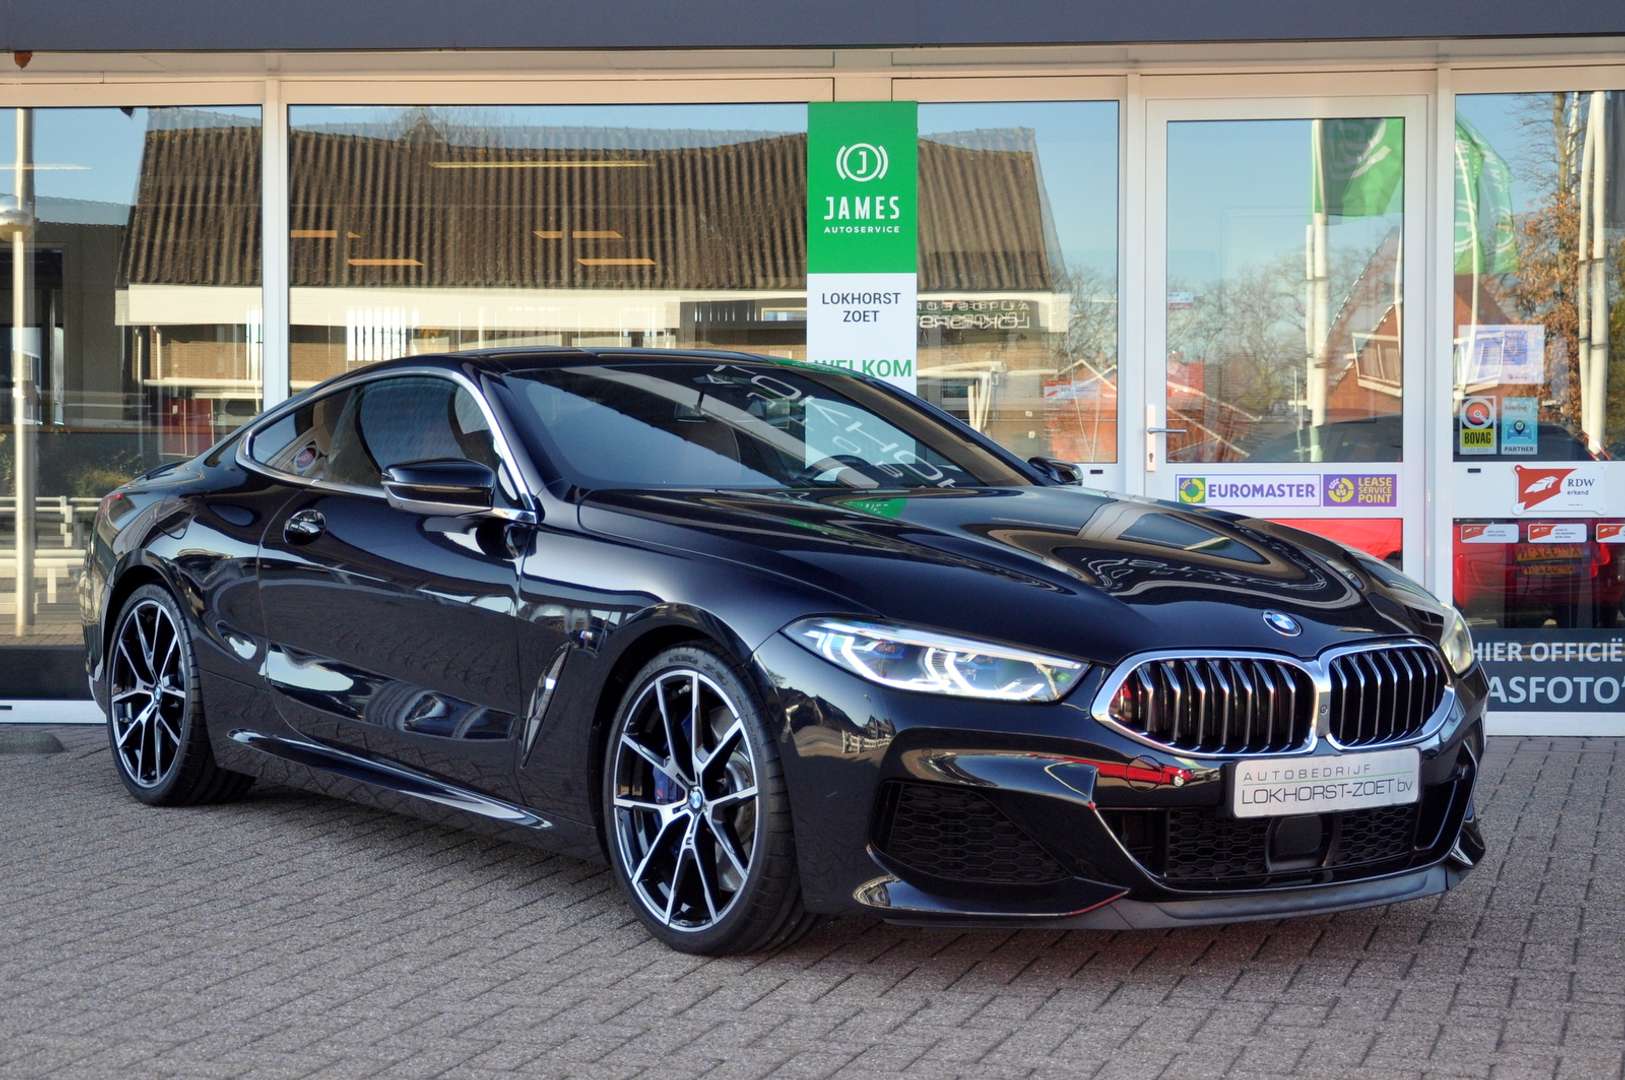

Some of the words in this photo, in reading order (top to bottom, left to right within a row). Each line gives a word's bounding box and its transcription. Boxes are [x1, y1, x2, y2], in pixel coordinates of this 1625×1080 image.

[824, 196, 901, 220] JAMES
[822, 293, 901, 305] LOKHORST
[843, 310, 880, 323] ZOET
[1464, 432, 1491, 444] BOVAG
[1358, 477, 1392, 486] LEASE
[1568, 479, 1595, 487] RDW
[1208, 484, 1315, 498] EUROMASTER
[1358, 494, 1392, 503] POINT
[1474, 642, 1522, 662] HIER
[1530, 638, 1623, 662] OFFICIË
[1243, 764, 1372, 782] AUTOBEDRIJF
[1242, 779, 1395, 805] LOKHORST-ZOET
[1397, 778, 1412, 793] bv
